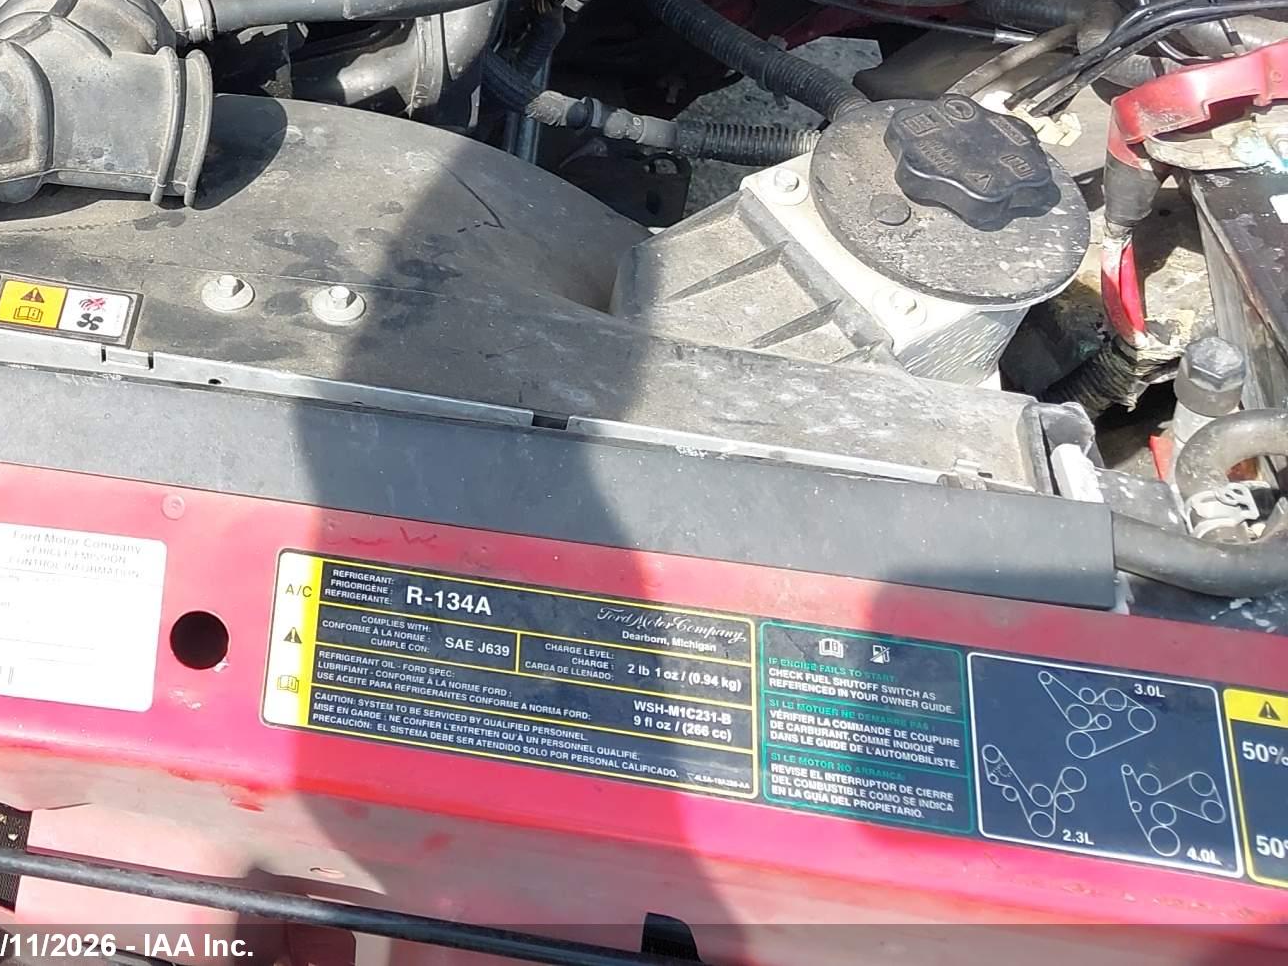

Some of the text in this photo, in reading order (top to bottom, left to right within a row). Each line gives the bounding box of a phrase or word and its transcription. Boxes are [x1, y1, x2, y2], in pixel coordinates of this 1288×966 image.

[43, 533, 79, 547] Motor
[82, 537, 143, 554] Company
[406, 585, 492, 616] R-134A
[322, 620, 425, 642] CONFORME LA NORME
[361, 615, 431, 633] COMPLIES WITH:
[596, 605, 631, 627] Ford
[670, 616, 746, 645] Company
[370, 637, 430, 653] CUMPLE CON:
[444, 637, 510, 657] SAE J639
[544, 642, 614, 660] CHARGE LEVEL:
[622, 630, 717, 653] Dearborn, Michigan
[319, 650, 455, 678] REFRIGERANT OIL FORD SPEC:
[524, 660, 614, 681] CARGA DE LLENADO:
[571, 657, 608, 670] CHARGE
[627, 663, 635, 674] 2
[638, 665, 649, 677] lb
[663, 668, 678, 681] oz
[688, 672, 719, 687] (0.94
[721, 677, 742, 691] kg)
[819, 664, 846, 675] FAILS
[849, 669, 862, 678] TO
[318, 661, 507, 696] LUBRIFIANT CONFORME LA NORME FORD
[768, 667, 936, 701] CHECK FUEL SHUTOFF SWITCH AS
[1134, 682, 1166, 698] 3.0L
[317, 671, 591, 720] USE ACEITE PARA REFRIGERANTES CONFORME NORMA FORD:
[768, 678, 955, 714] REFERENCED IN YOUR OWNER GUIDE.
[314, 691, 356, 705] CAUTION:
[357, 698, 393, 711] SYSTEM
[394, 704, 407, 713] TO
[409, 706, 421, 715] BE
[423, 708, 467, 722] SERVICED
[468, 715, 481, 725] BY
[482, 717, 530, 732] QUALIFIED
[313, 702, 334, 713] MISE
[336, 706, 349, 715] EN
[350, 708, 381, 720] GARDE
[388, 714, 401, 723] NE
[402, 716, 441, 729] CONFIER
[525, 735, 538, 745] UN
[540, 737, 594, 754] PERSONNEL
[633, 714, 640, 726] 9
[644, 716, 652, 728] fl
[656, 718, 670, 731] oz
[711, 726, 732, 742] cc)
[769, 720, 784, 731] DE
[852, 733, 890, 747] COMME
[816, 717, 830, 727] LA
[832, 719, 891, 737] COMMANDE
[893, 729, 907, 739] DE
[909, 731, 960, 747] COUPURE
[389, 725, 428, 739] SISTEMA
[429, 731, 454, 743] DEBE
[455, 735, 474, 746] SER
[475, 738, 520, 753] ATENDIDO
[522, 745, 547, 757] SOLO
[549, 750, 568, 761] POR
[571, 753, 619, 769] PERSONAL
[621, 761, 679, 778] CALIFICADO.
[770, 731, 798, 744] DANS
[800, 735, 814, 746] LE
[815, 738, 846, 751] GUIDE
[849, 743, 863, 754] DE
[783, 754, 795, 763] LE
[798, 757, 834, 770] MOTOR
[770, 763, 954, 801] REVISE EL INTERRUPTOR DE CIERRE
[771, 774, 953, 812] DEL COMBUSTIBLE COMO SE INDICA
[771, 785, 786, 796] EN
[788, 788, 801, 798] LA
[830, 794, 851, 806] DEL
[853, 798, 924, 818] PROPIETARIO.
[1062, 829, 1094, 845] 2.3L
[1186, 845, 1223, 865] 4.0L
